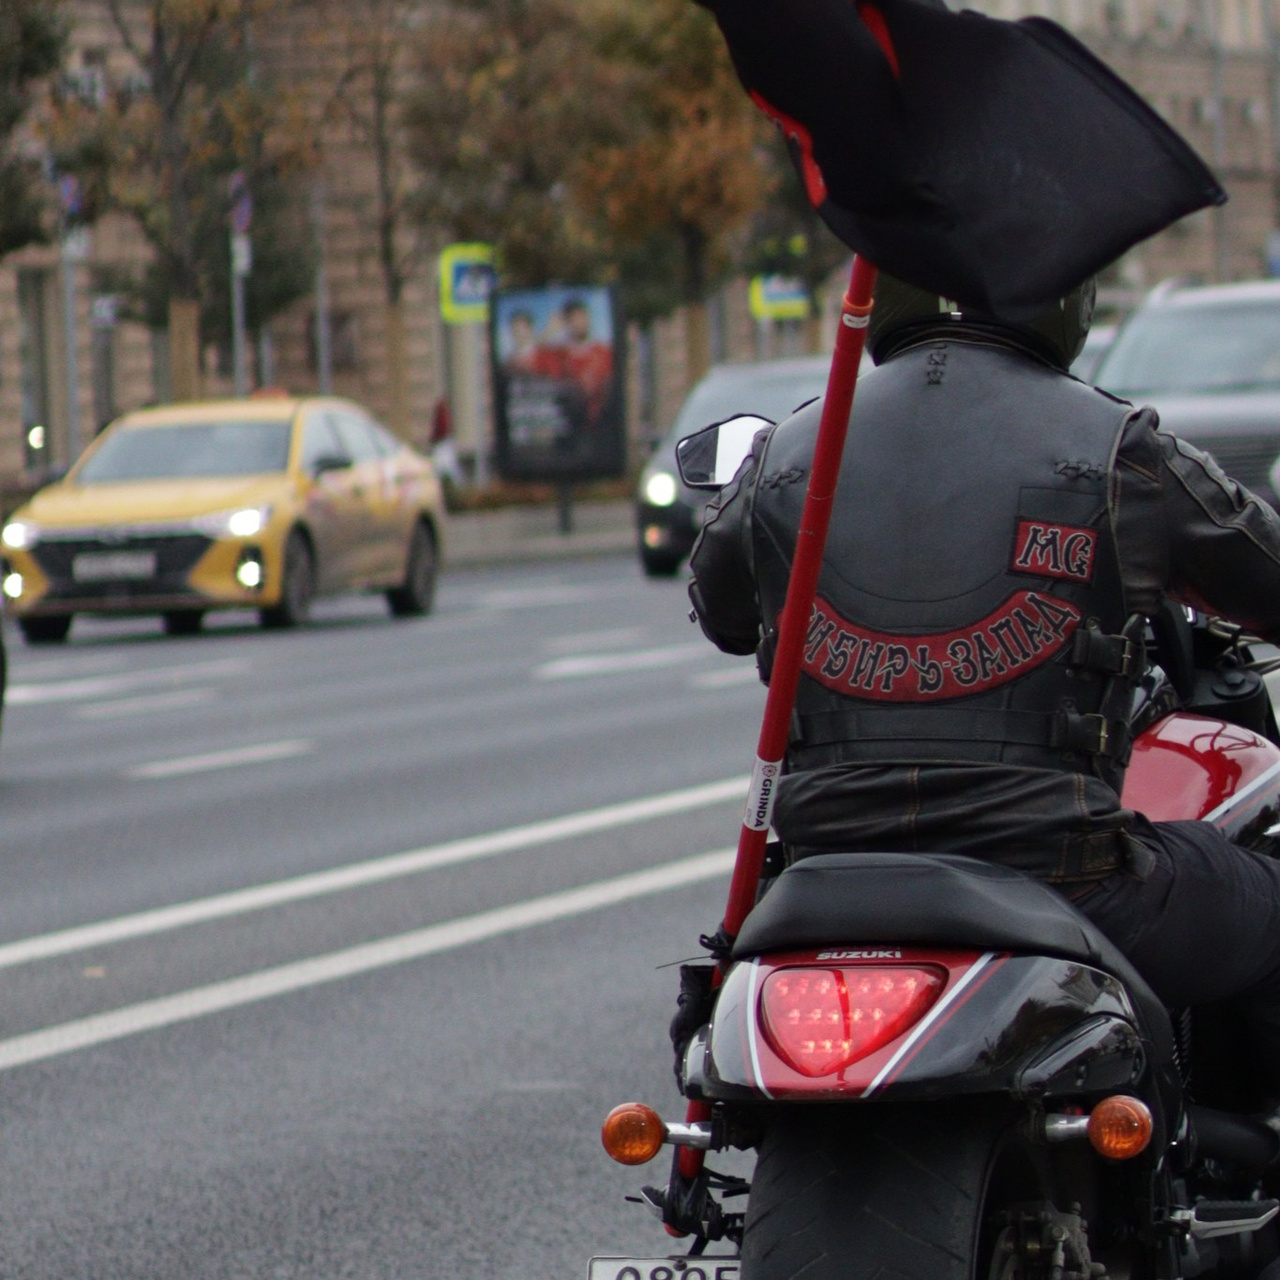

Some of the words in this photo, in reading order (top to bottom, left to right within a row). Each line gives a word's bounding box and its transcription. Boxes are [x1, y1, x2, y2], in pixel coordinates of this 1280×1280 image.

[804, 592, 1081, 693] ИБИРЬ-ЗАПАД
[754, 778, 772, 828] GRINDA
[816, 950, 902, 961] SUZUKI
